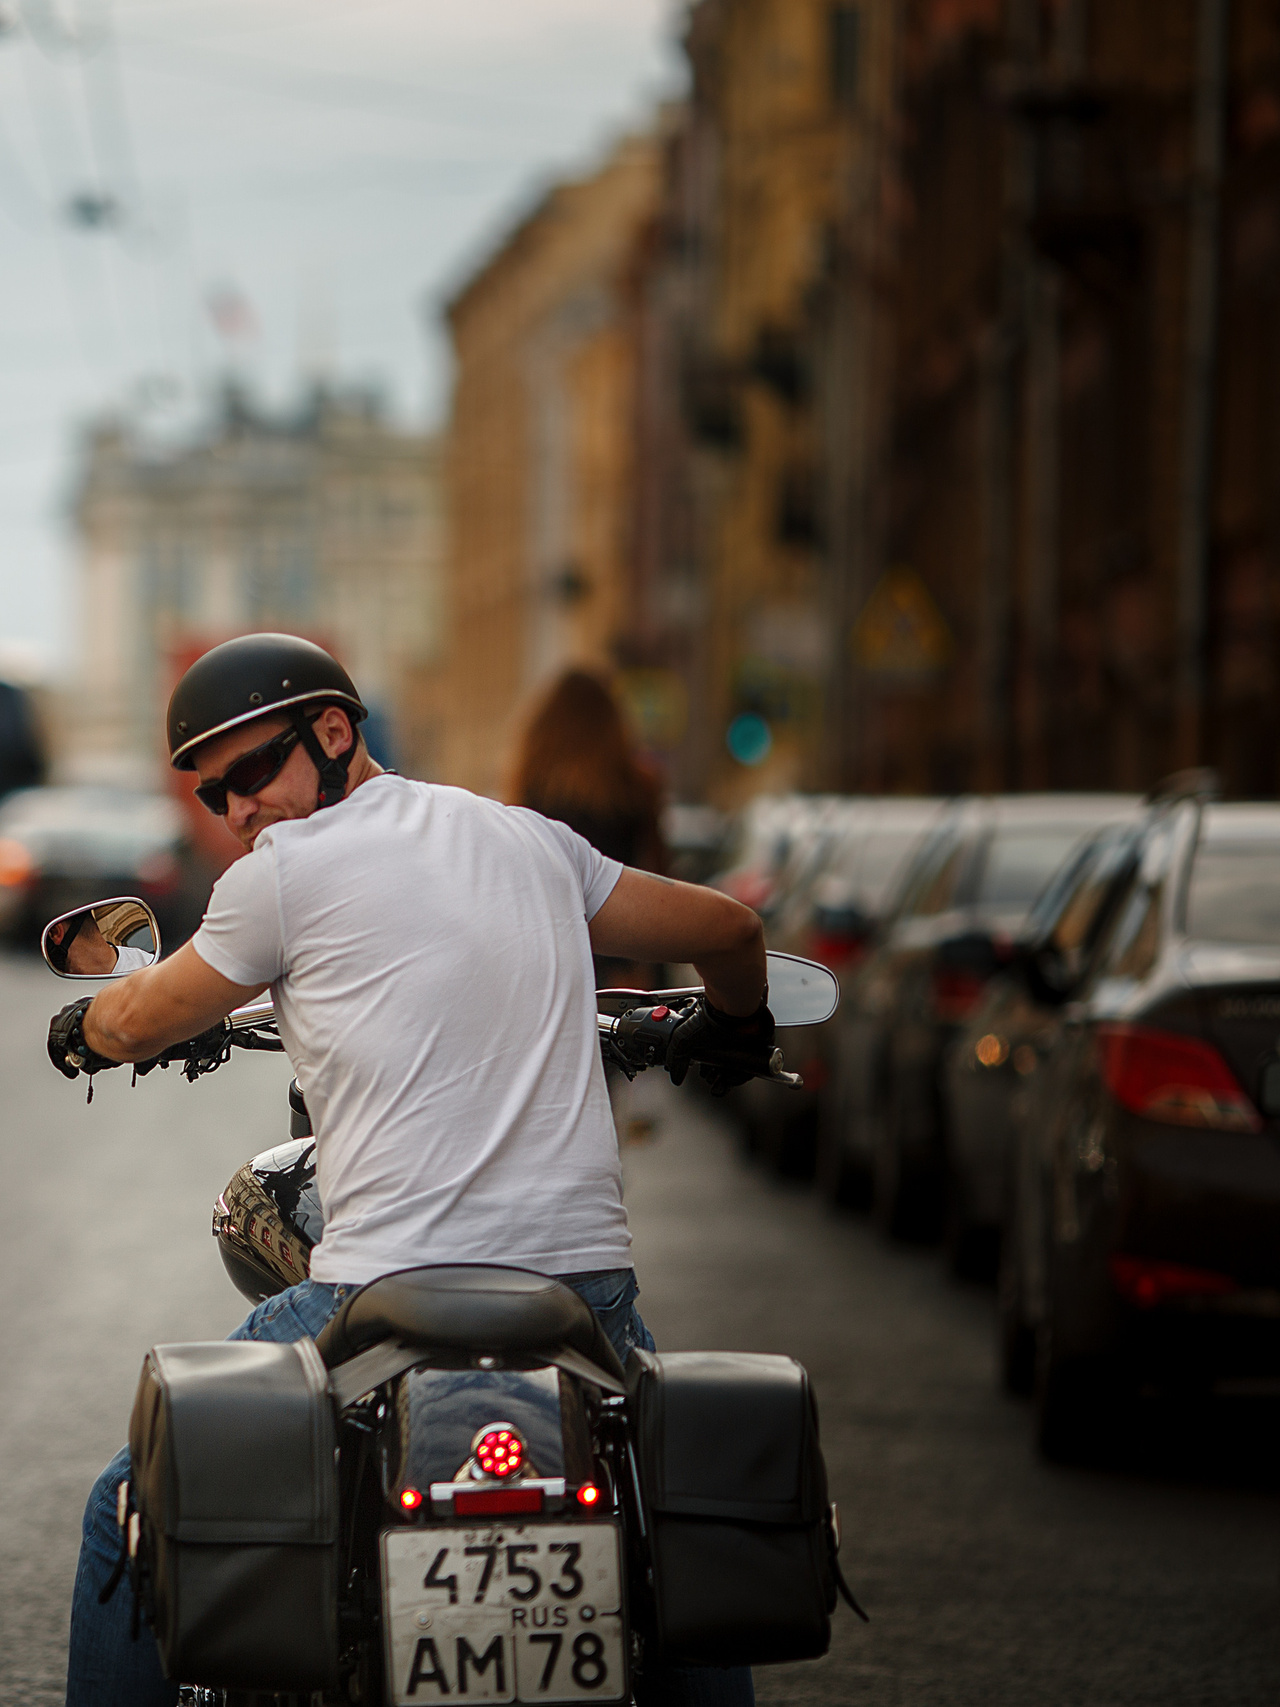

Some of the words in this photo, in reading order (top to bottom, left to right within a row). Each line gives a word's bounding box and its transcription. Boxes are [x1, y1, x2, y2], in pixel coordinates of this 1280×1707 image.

[424, 1542, 584, 1604] 4753
[511, 1605, 569, 1628] RUS
[406, 1635, 506, 1695] AM
[529, 1632, 608, 1692] 78
